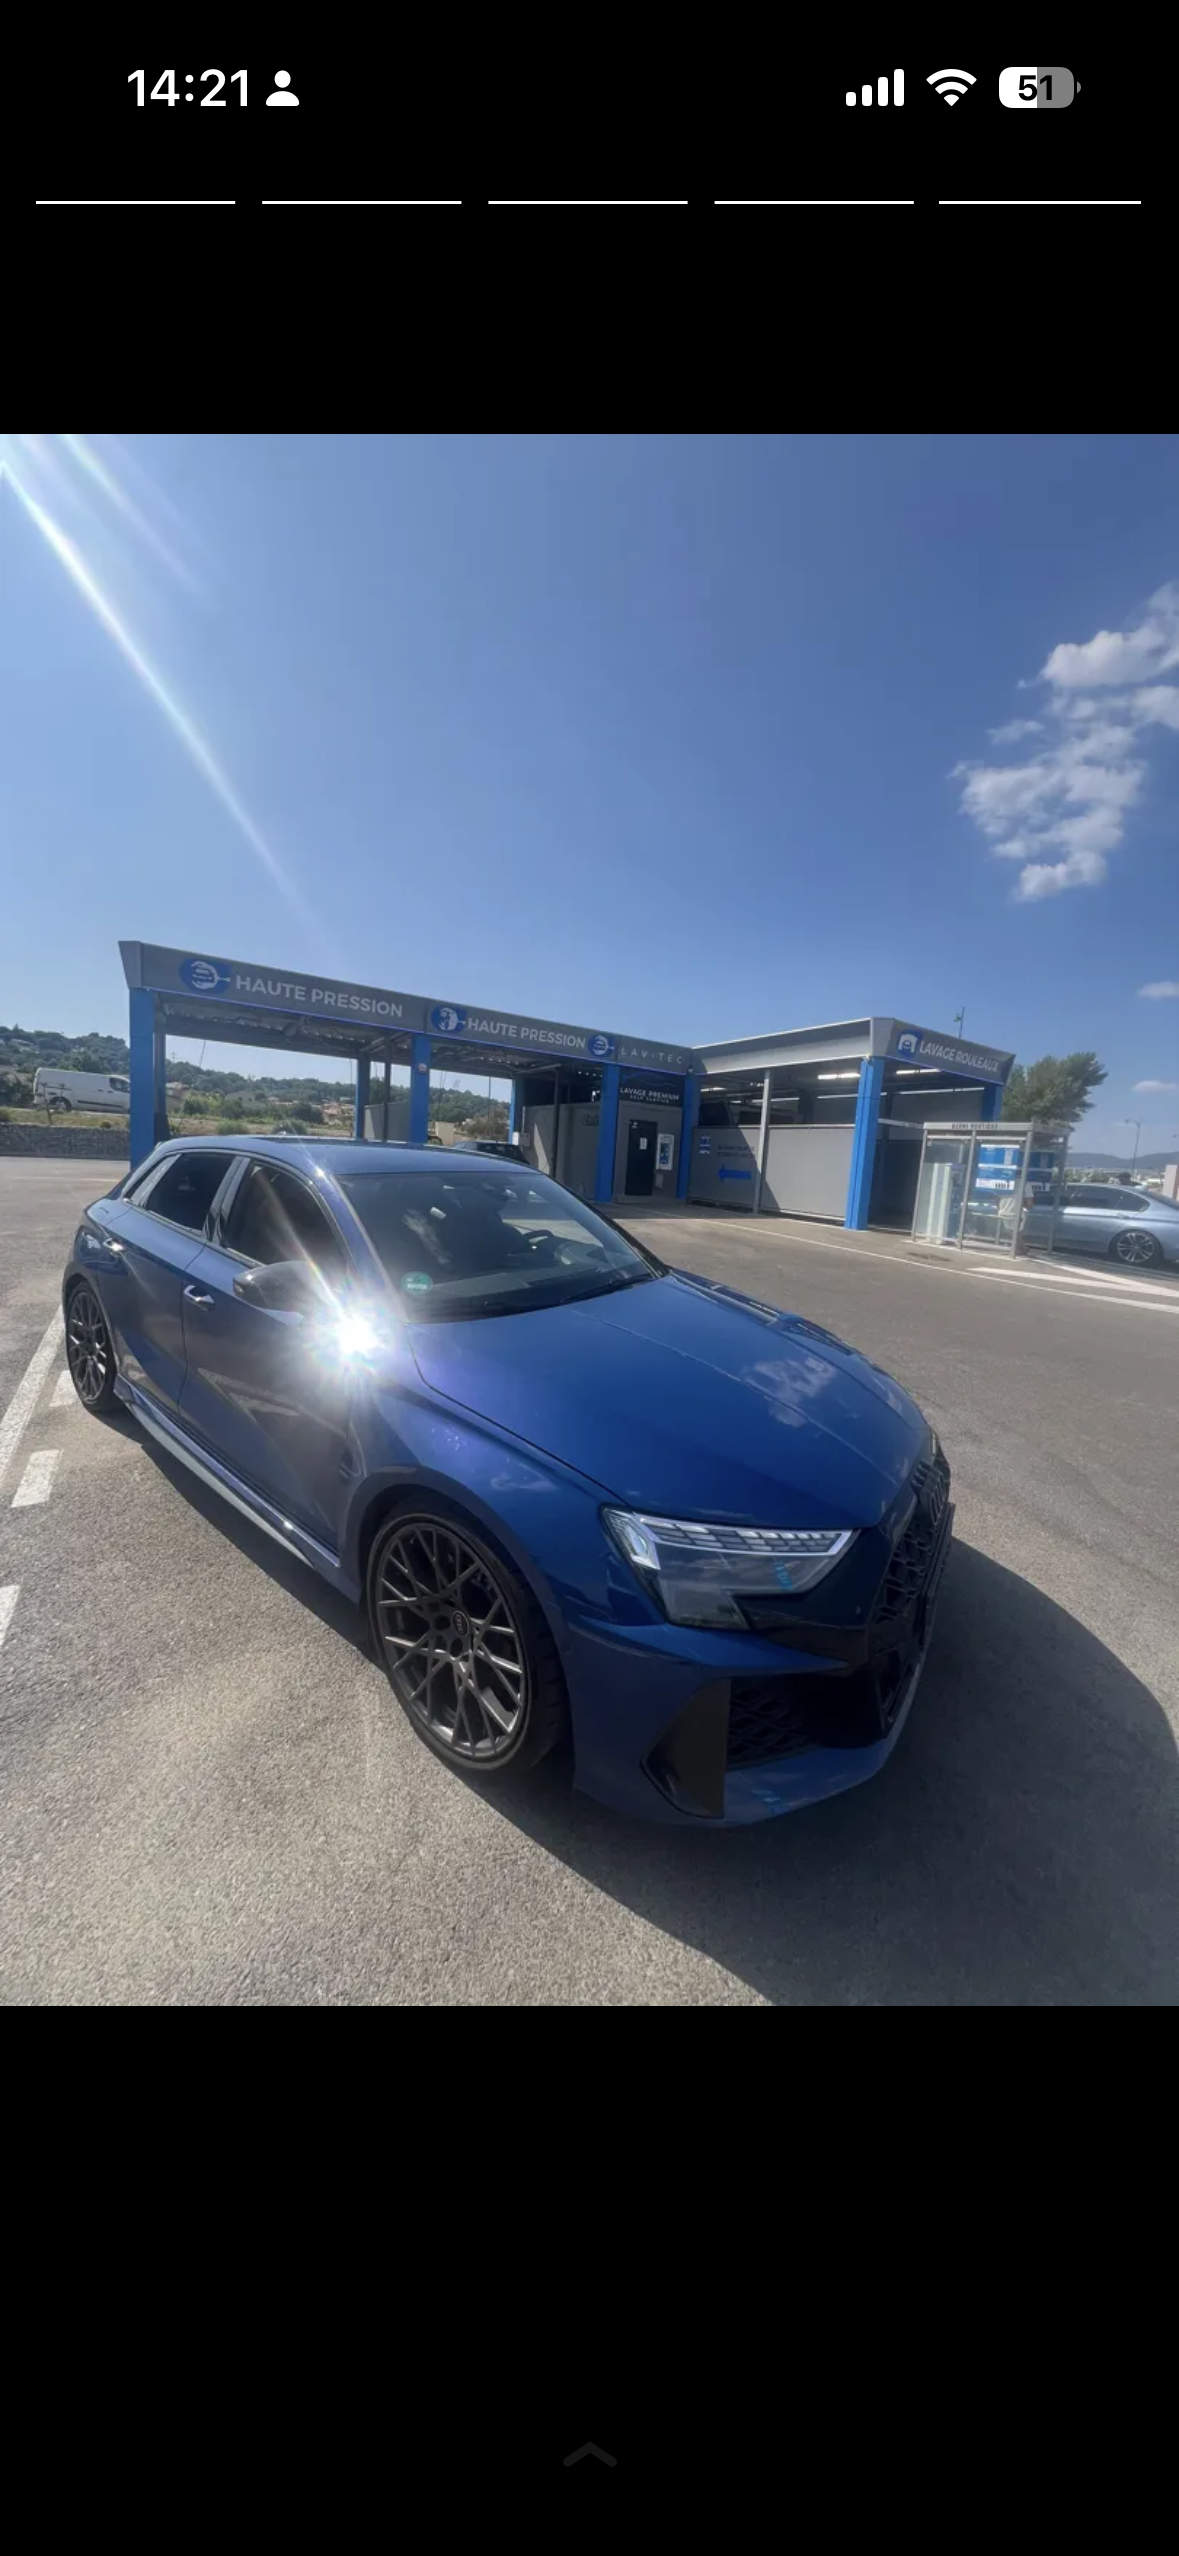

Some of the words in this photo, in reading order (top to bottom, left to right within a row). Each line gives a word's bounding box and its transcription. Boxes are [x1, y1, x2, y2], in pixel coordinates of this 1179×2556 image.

[235, 974, 307, 1002] HAUTE
[311, 988, 403, 1018] PRESSION
[467, 1017, 518, 1038] HAUTE
[520, 1026, 586, 1050] PRESSION
[919, 1040, 957, 1061] LAVAGE
[955, 1050, 999, 1073] ROULEAUX
[619, 1087, 646, 1097] LAVAGE
[648, 1090, 679, 1100] PREMIUM
